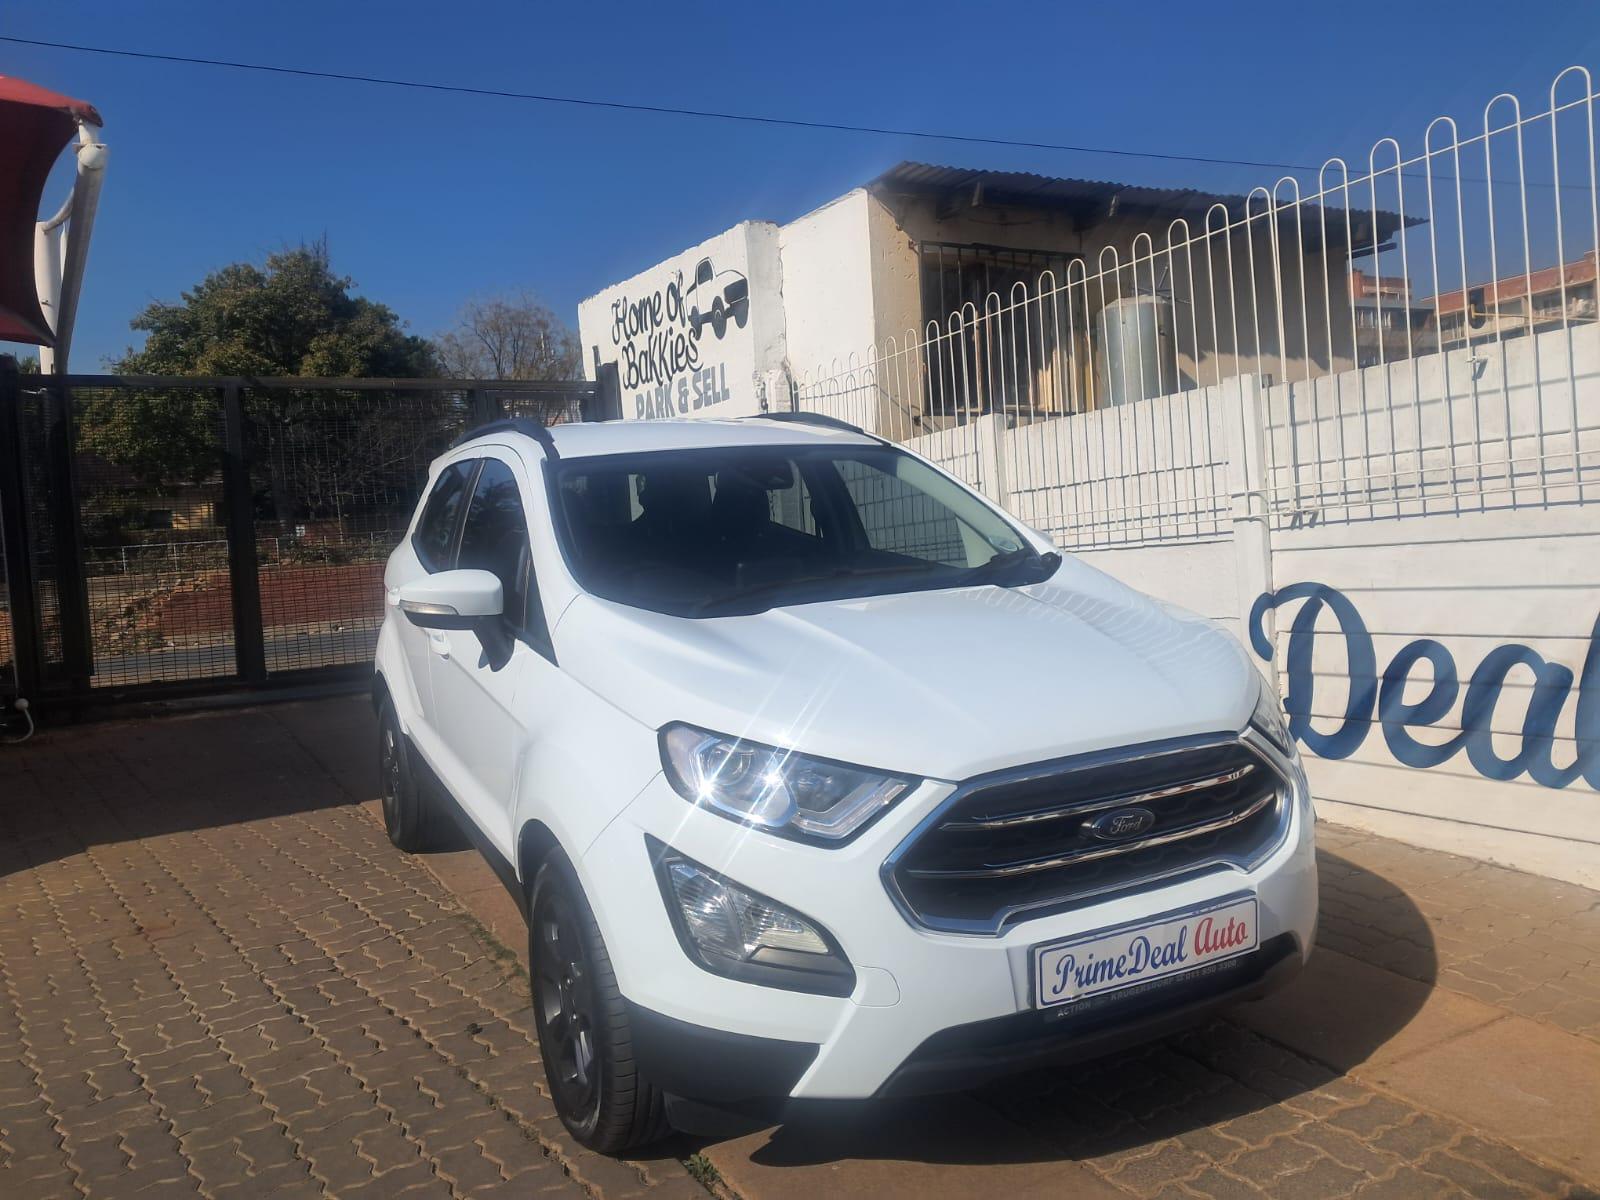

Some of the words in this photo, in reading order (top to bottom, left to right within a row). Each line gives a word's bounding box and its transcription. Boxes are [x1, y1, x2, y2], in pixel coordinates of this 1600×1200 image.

[611, 290, 664, 345] Home
[635, 382, 676, 420] PARK
[677, 376, 690, 414] &
[692, 362, 730, 410] SELL
[1109, 814, 1144, 835] Ford
[1052, 924, 1188, 995] PrimeDeal
[1194, 916, 1249, 956] Auto
[1057, 1000, 1092, 1018] ACTION
